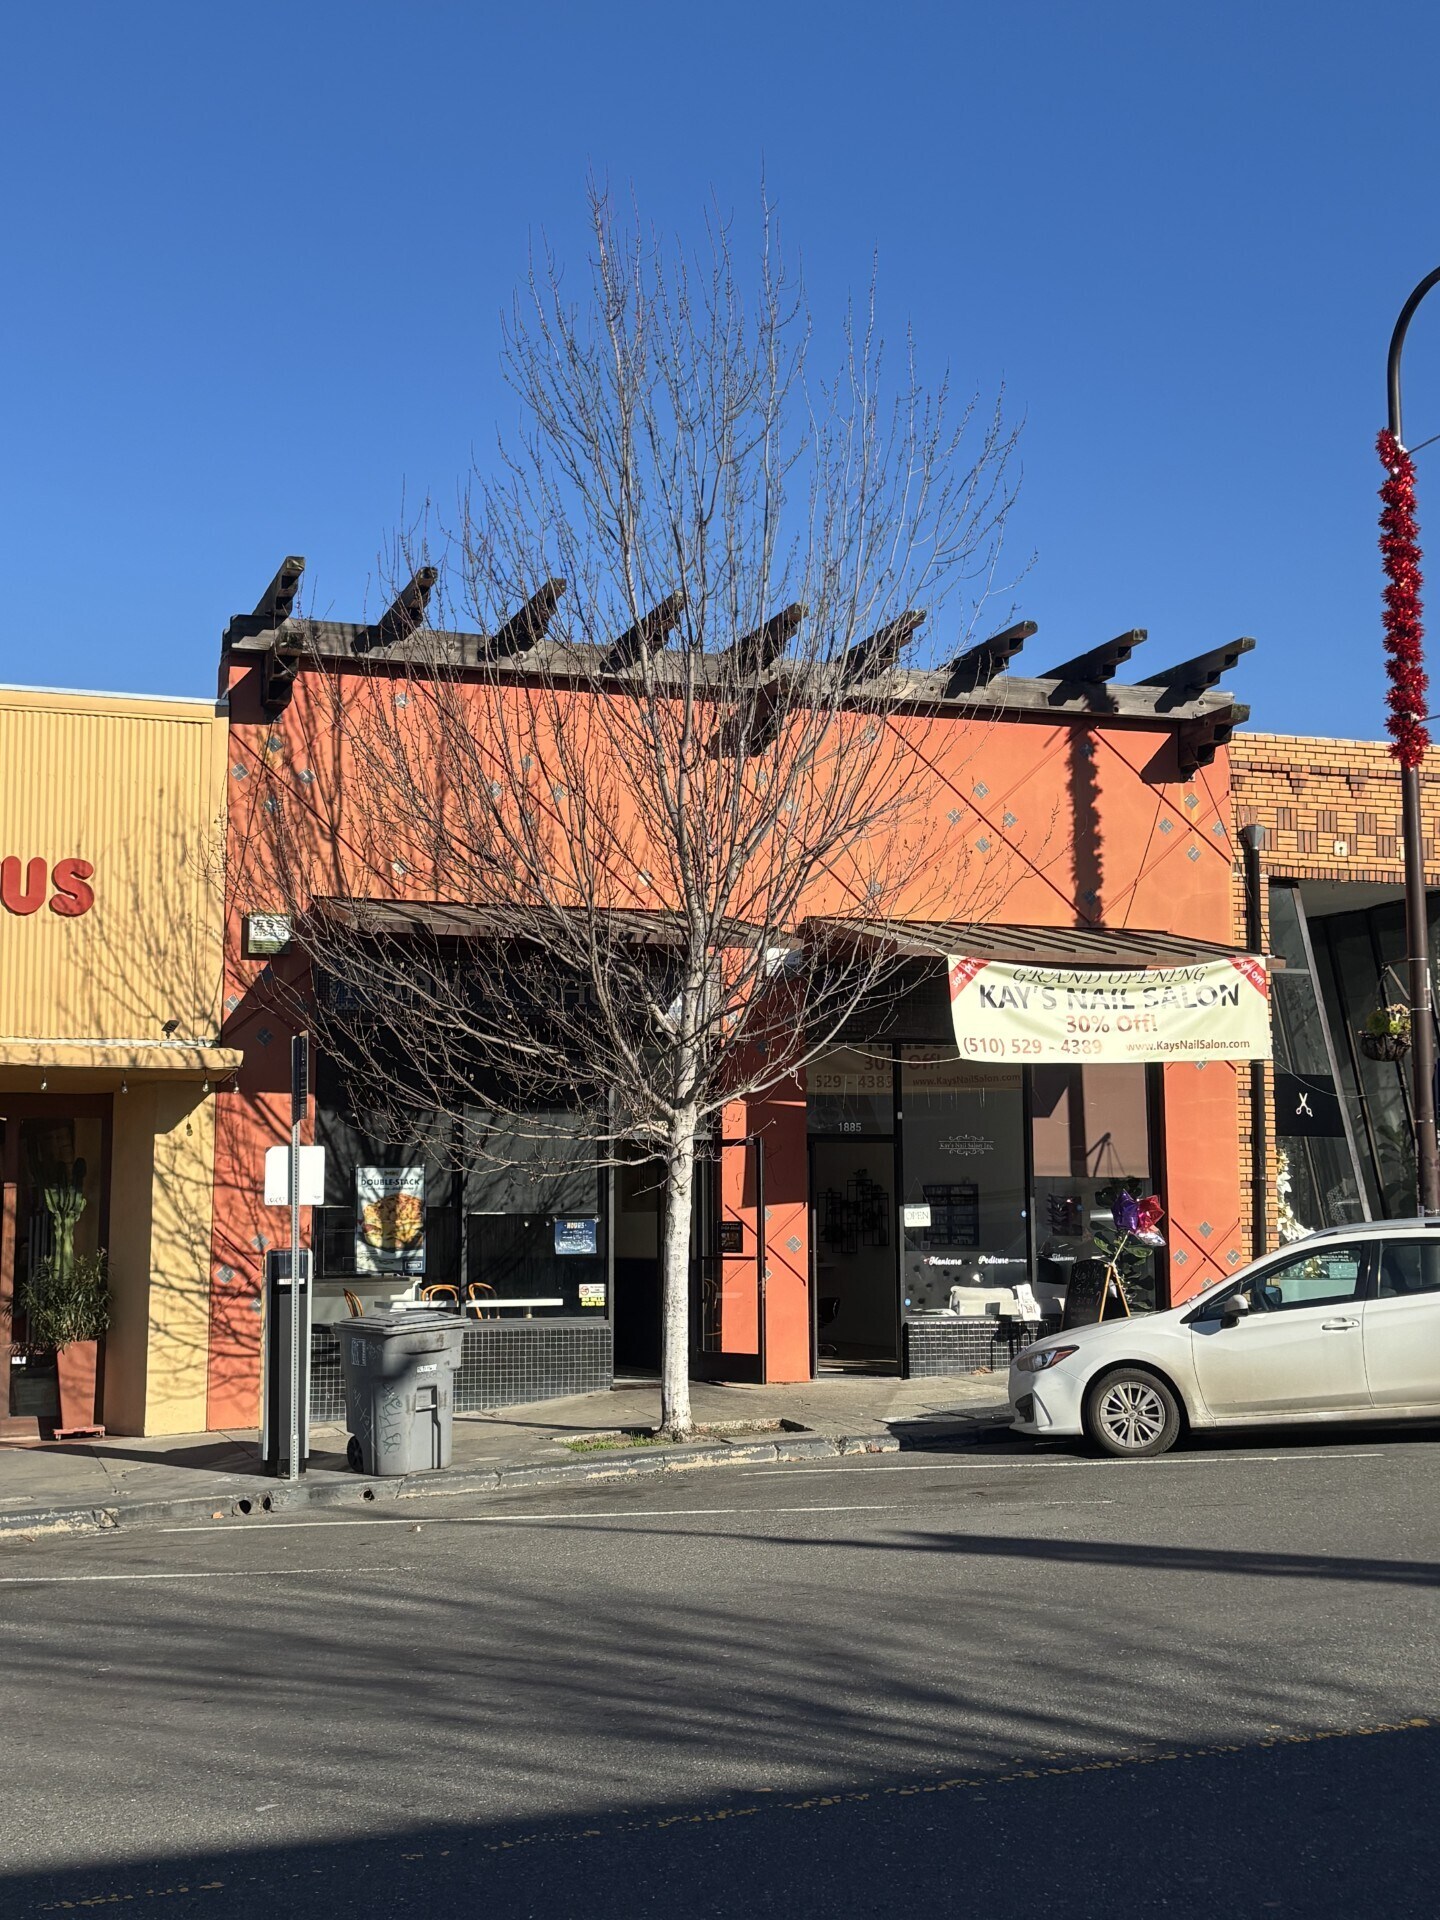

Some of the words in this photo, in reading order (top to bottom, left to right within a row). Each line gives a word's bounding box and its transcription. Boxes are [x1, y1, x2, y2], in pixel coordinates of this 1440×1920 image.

[979, 984, 1057, 1010] KAY'S
[1066, 987, 1135, 1010] NAIL
[1143, 982, 1240, 1009] SALON
[1065, 1015, 1110, 1033] 30%
[1116, 1013, 1158, 1033] Off!
[963, 1037, 1005, 1056] (510)
[1011, 1038, 1042, 1055] 529
[1061, 1039, 1103, 1055] 4389
[1126, 1038, 1250, 1053] www.KaysNailSalon.com
[838, 1122, 862, 1132] 1885
[906, 1212, 929, 1220] OPEN
[978, 1255, 1009, 1265] Pedicure
